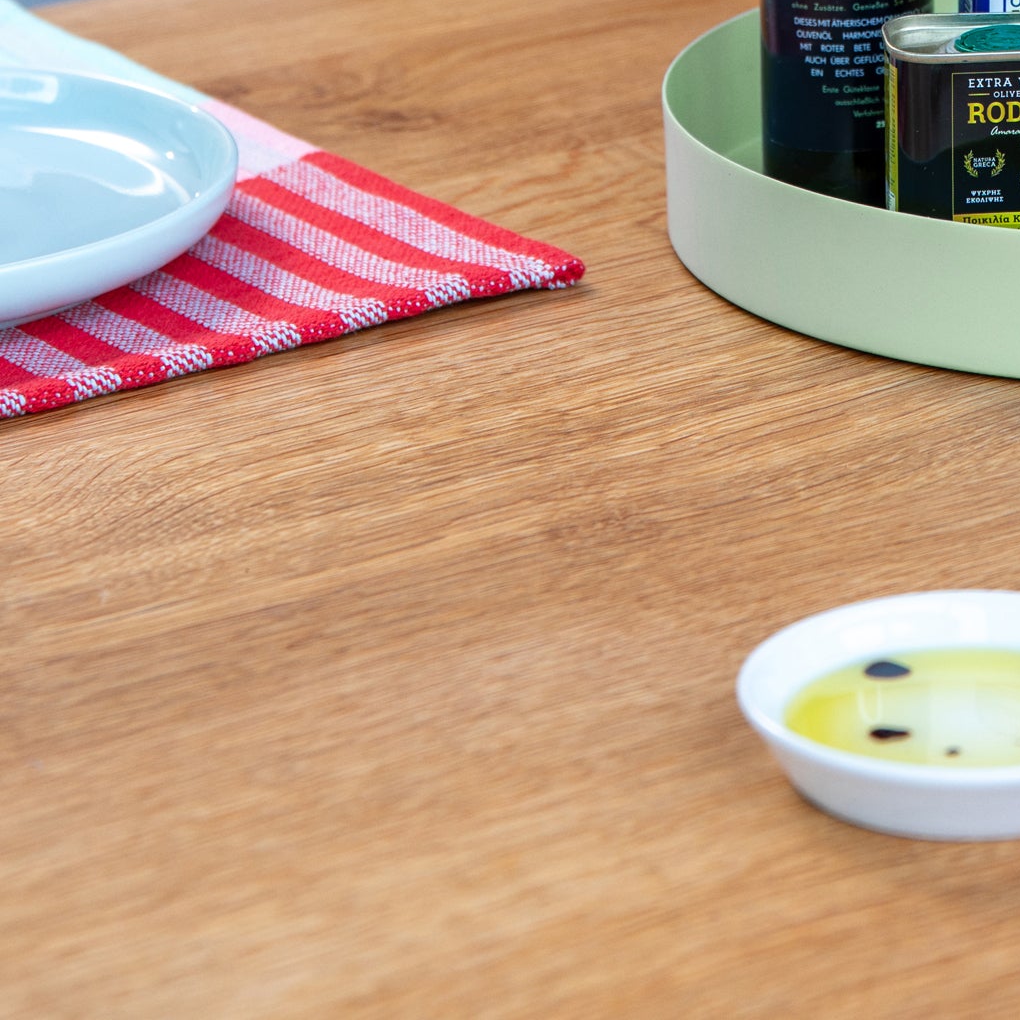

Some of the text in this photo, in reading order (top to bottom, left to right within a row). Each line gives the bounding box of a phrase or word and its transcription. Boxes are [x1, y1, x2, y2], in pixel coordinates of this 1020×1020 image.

[793, 16, 884, 28] DIESES MIT ÄTHERISCHEM
[796, 29, 833, 41] OLIVENÖL
[800, 42, 813, 52] MIT
[820, 43, 846, 53] ROTER
[853, 42, 872, 53] BETE
[804, 54, 827, 65] AUCH
[829, 54, 850, 66] ÜBER
[810, 68, 824, 77] EIN
[835, 68, 865, 78] ECHTES
[968, 77, 1013, 89] EXTRA
